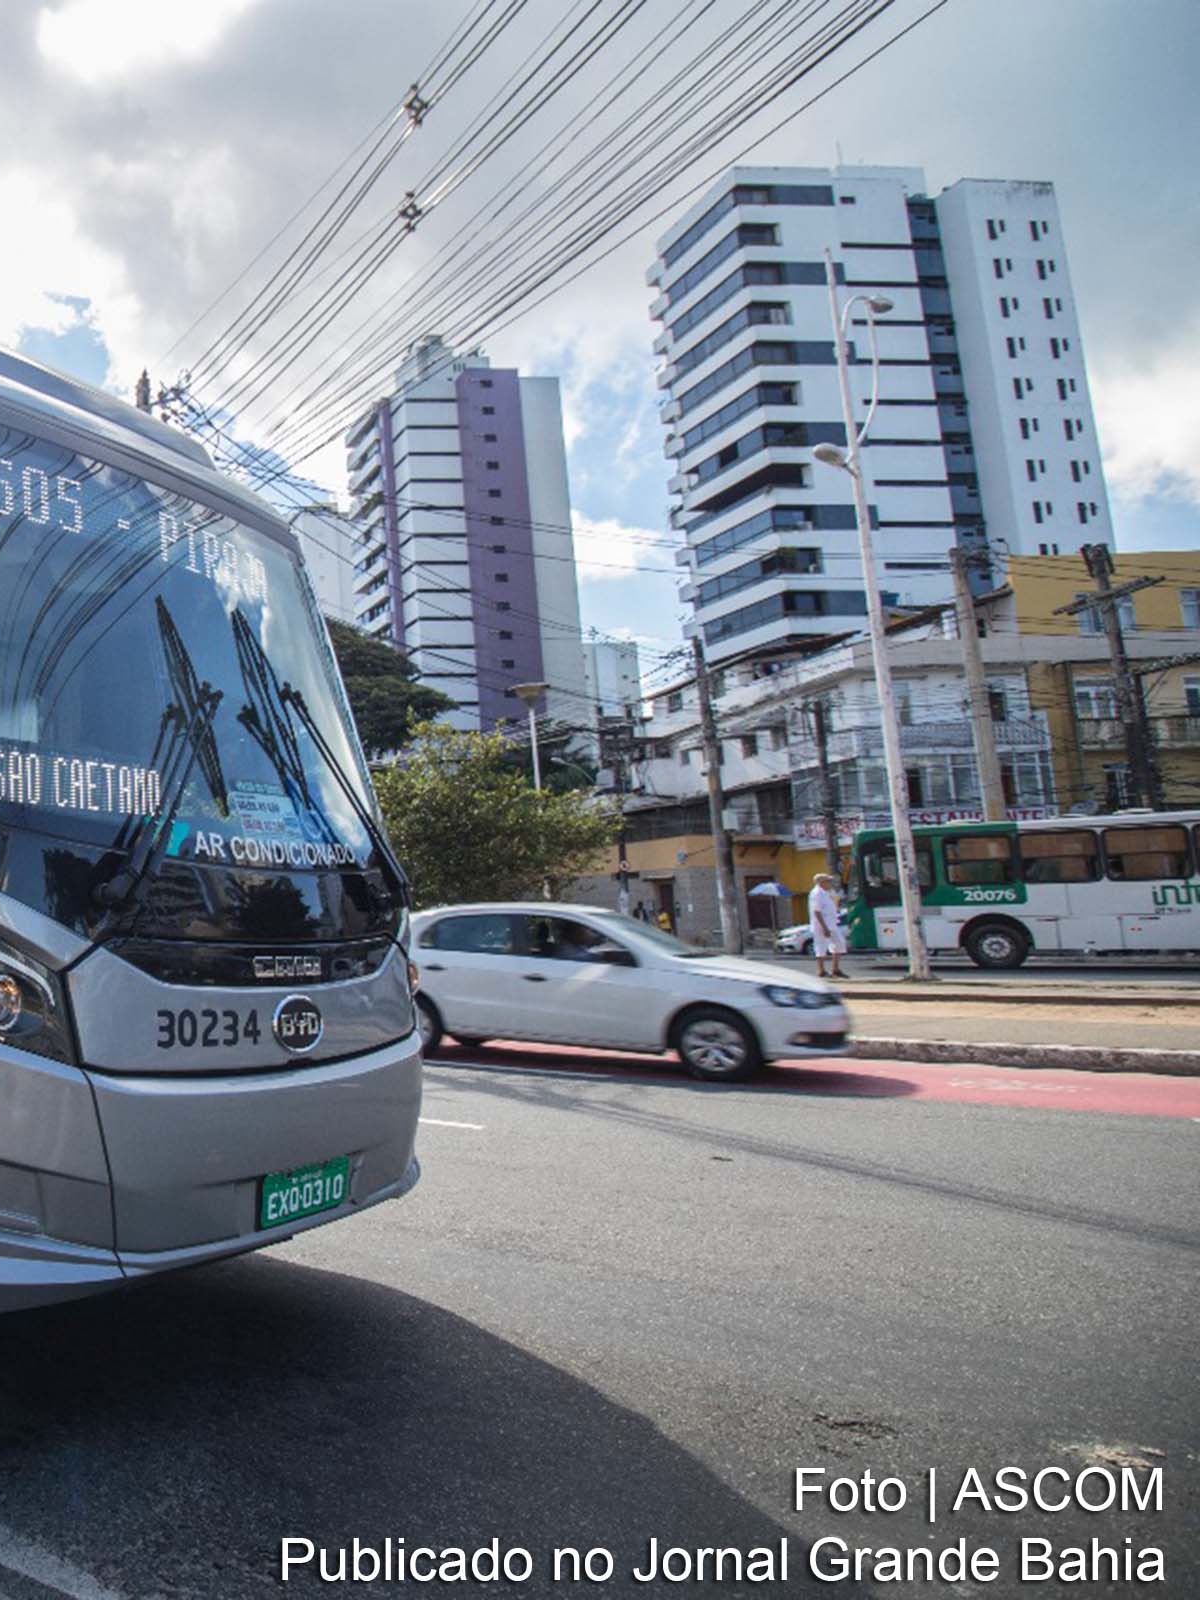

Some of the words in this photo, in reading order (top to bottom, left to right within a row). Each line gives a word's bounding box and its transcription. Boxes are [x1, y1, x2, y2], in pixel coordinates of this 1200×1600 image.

[53, 757, 161, 816] CAETANO
[194, 830, 227, 859] AR
[230, 836, 356, 867] CONDICIONADO
[962, 887, 1017, 902] 20076
[156, 1008, 261, 1050] 30234
[281, 1012, 320, 1038] BYD
